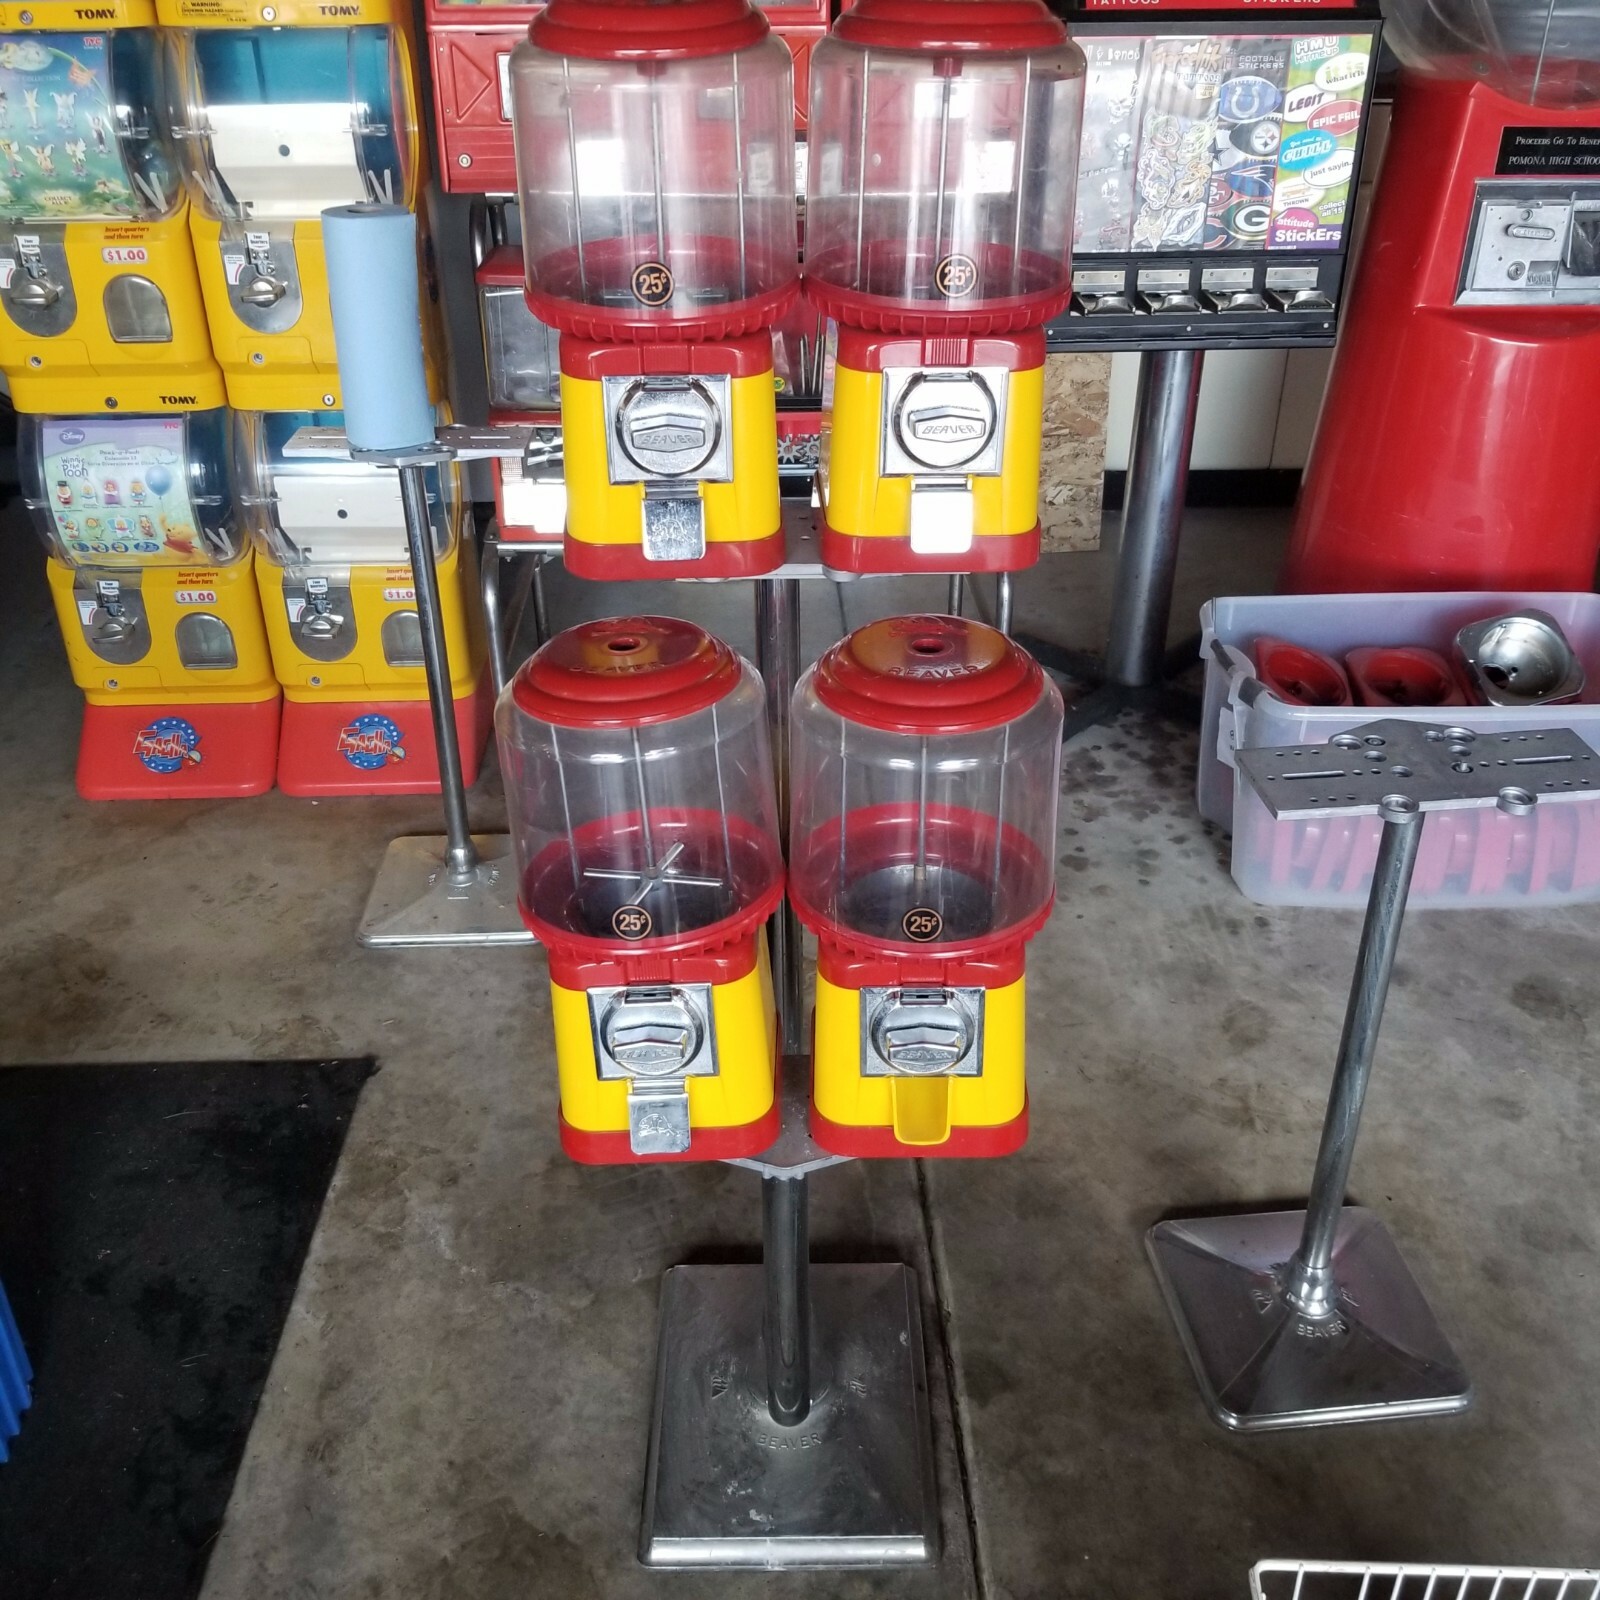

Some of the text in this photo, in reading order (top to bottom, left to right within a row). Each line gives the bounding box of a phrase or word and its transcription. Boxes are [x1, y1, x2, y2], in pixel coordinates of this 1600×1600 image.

[74, 8, 115, 19] TOMY
[318, 5, 359, 16] TOMY
[1295, 35, 1338, 56] HMU
[1288, 92, 1325, 113] LEGIT
[1313, 115, 1336, 128] EPIC
[1508, 156, 1546, 165] POMONA
[1549, 156, 1572, 165] HIGH
[1310, 167, 1326, 178] just
[1319, 199, 1346, 211] collect
[1277, 216, 1315, 229] attitude
[1274, 228, 1342, 242] StickErs
[107, 250, 146, 261] $1.00
[159, 396, 197, 405] TOMY
[922, 424, 976, 435] BEAVER
[61, 431, 84, 441] Disney
[641, 434, 695, 445] BEAVER
[60, 455, 86, 465] Winnie
[62, 465, 89, 478] Pooh
[180, 592, 215, 602] $1.00
[619, 914, 646, 931] 25¢
[910, 916, 937, 933] 25¢
[1298, 1320, 1347, 1338] BEAVER
[756, 1432, 823, 1450] BEAVER
